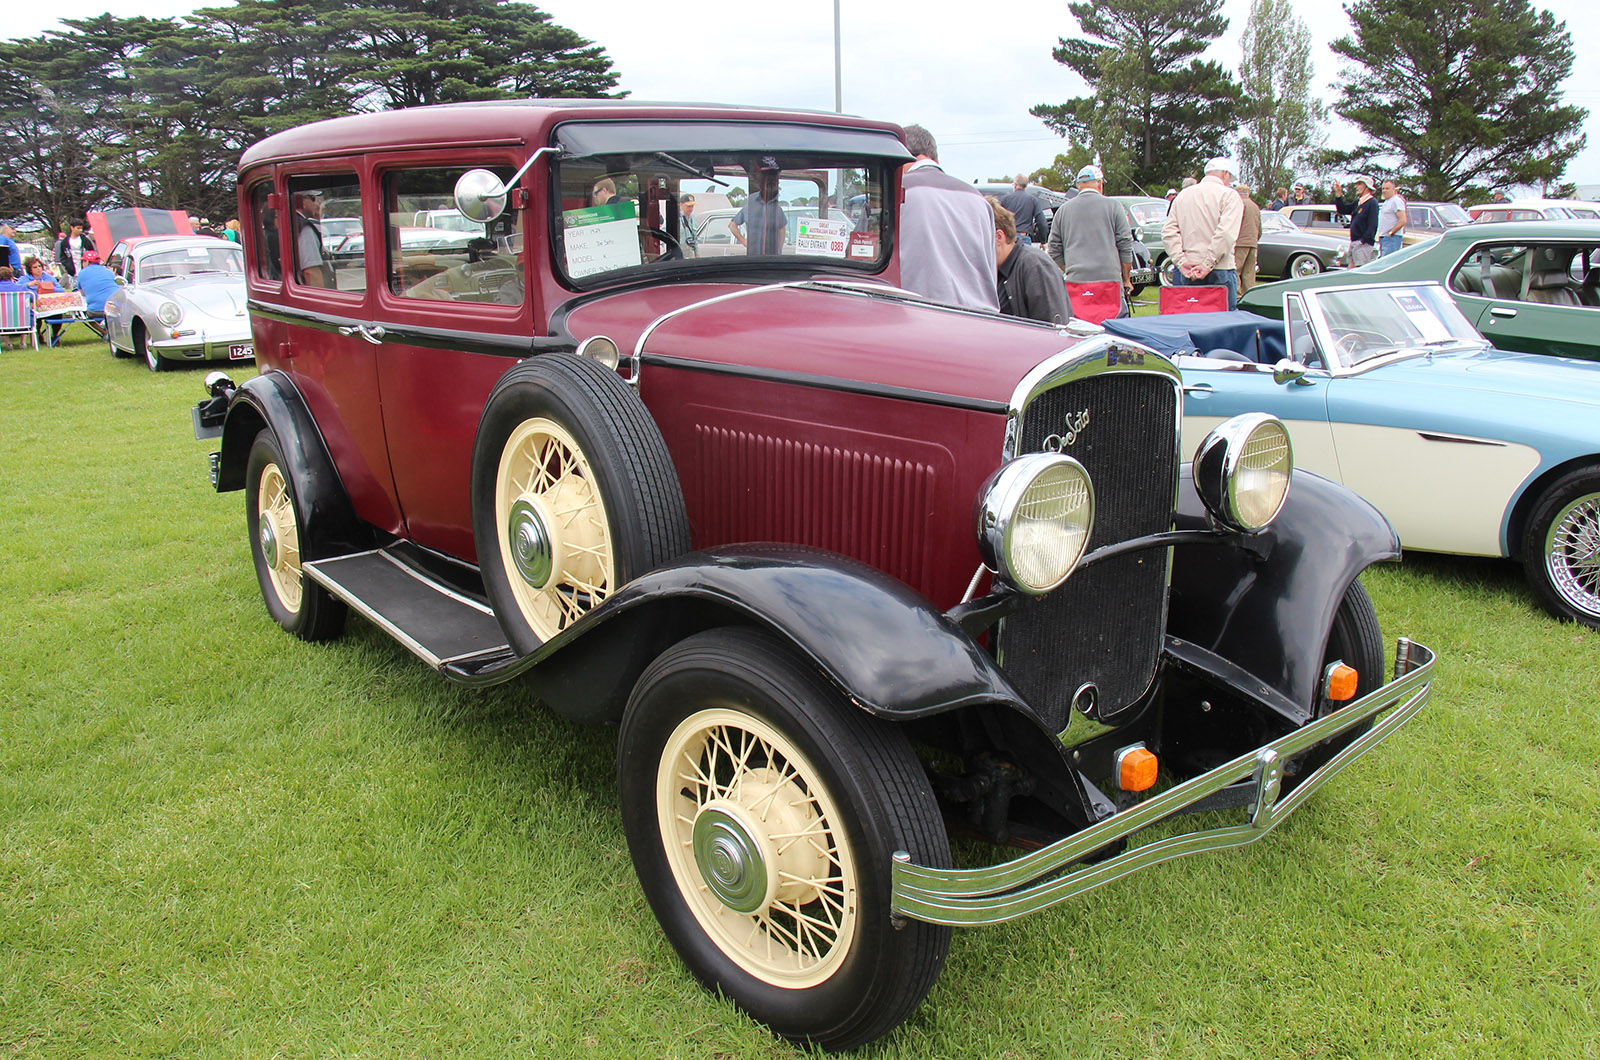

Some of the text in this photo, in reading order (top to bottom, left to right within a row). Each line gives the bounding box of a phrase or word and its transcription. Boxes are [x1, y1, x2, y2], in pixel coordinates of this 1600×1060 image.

[568, 230, 584, 238] YEAR
[570, 242, 588, 251] MAKE
[798, 239, 828, 249] RALLY ENTRANT
[830, 240, 844, 252] 0383
[572, 255, 594, 265] MODEL
[574, 267, 597, 278] OWNER
[233, 347, 253, 356] 1245
